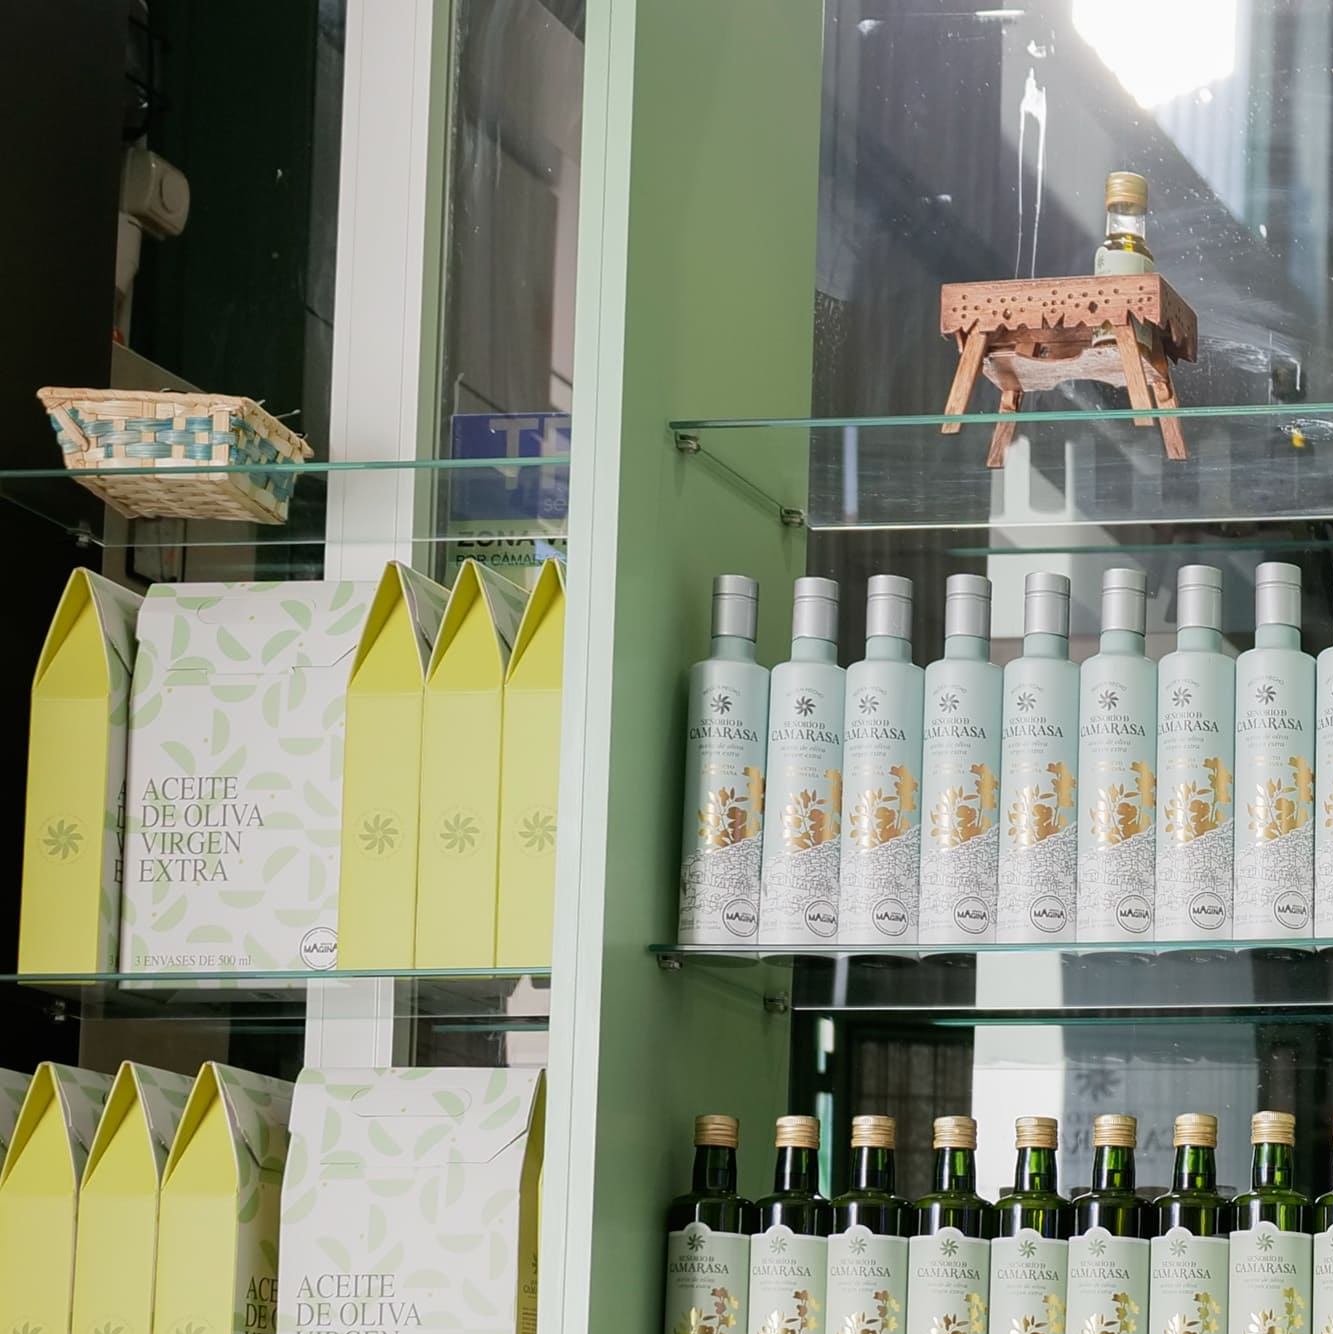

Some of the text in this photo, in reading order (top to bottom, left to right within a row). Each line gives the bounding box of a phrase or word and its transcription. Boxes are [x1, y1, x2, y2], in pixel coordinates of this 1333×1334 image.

[458, 530, 535, 547] ZONA
[690, 727, 759, 742] CAMARASA
[772, 731, 840, 745] CAMARASA
[142, 776, 239, 801] ACEITE
[141, 804, 265, 829] DE OLIVA
[142, 831, 242, 854] VIRGEN
[139, 859, 228, 882] EXTRA
[135, 954, 252, 966] 3 ENVASES DE 500 ml
[670, 1262, 729, 1275] CAMARASA
[997, 1269, 1059, 1281] CAMARASA
[1071, 1268, 1130, 1280] CAMARASA
[1152, 1267, 1211, 1280] CAMARASA
[296, 1274, 395, 1299] ACEITE
[245, 1304, 267, 1327] DE
[296, 1302, 422, 1327] DE OLIVA
